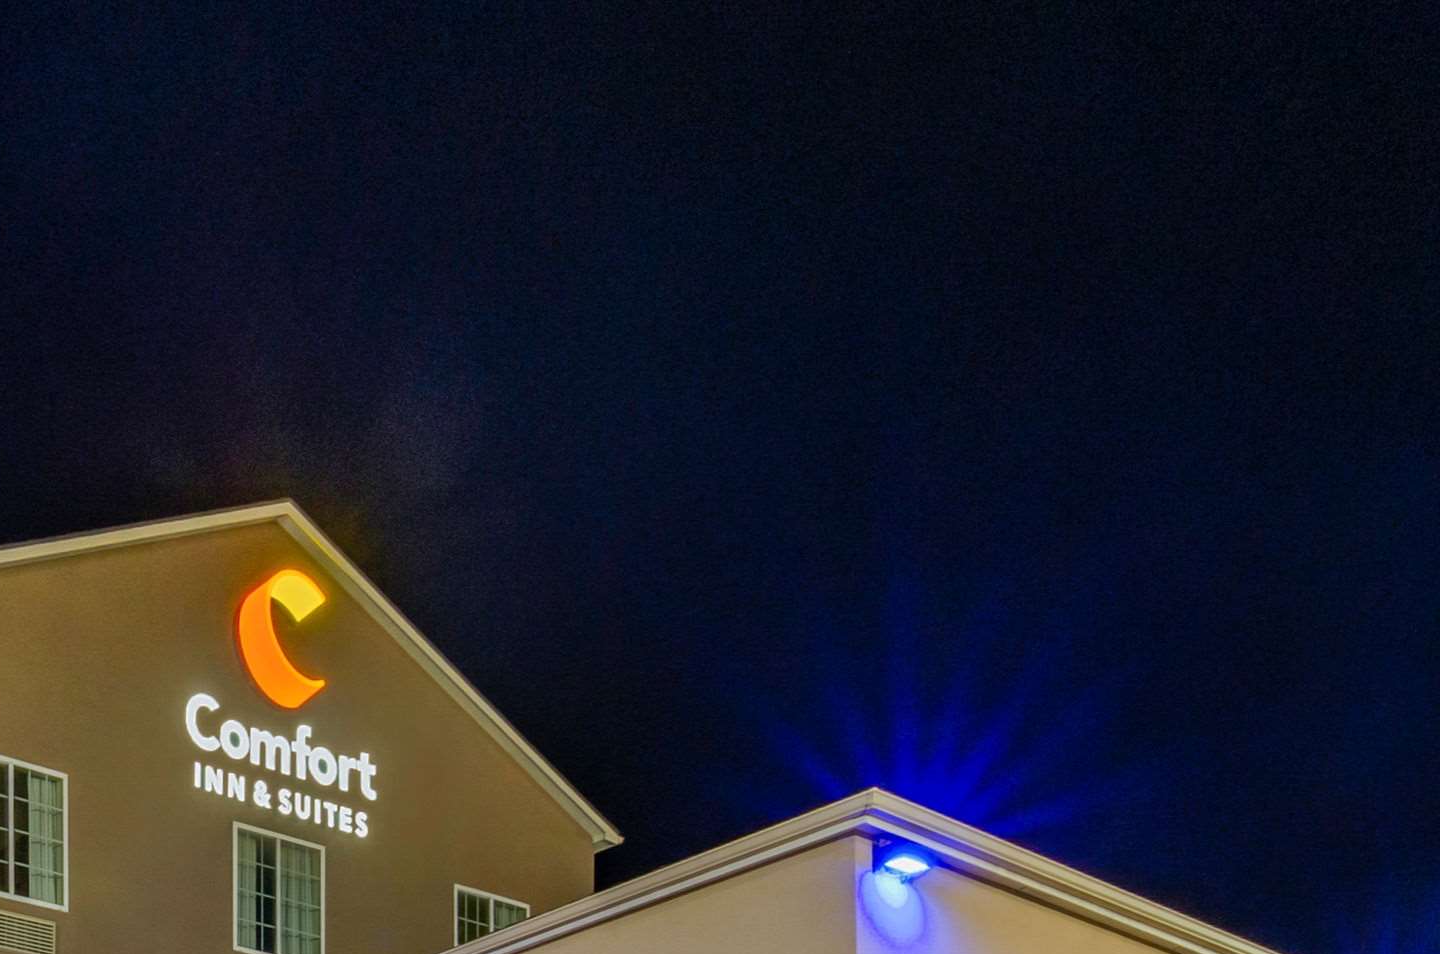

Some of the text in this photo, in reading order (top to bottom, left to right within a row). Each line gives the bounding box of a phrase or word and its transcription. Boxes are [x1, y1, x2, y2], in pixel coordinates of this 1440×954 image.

[185, 692, 377, 801] Comfort
[194, 761, 369, 839] INN & SUITES
